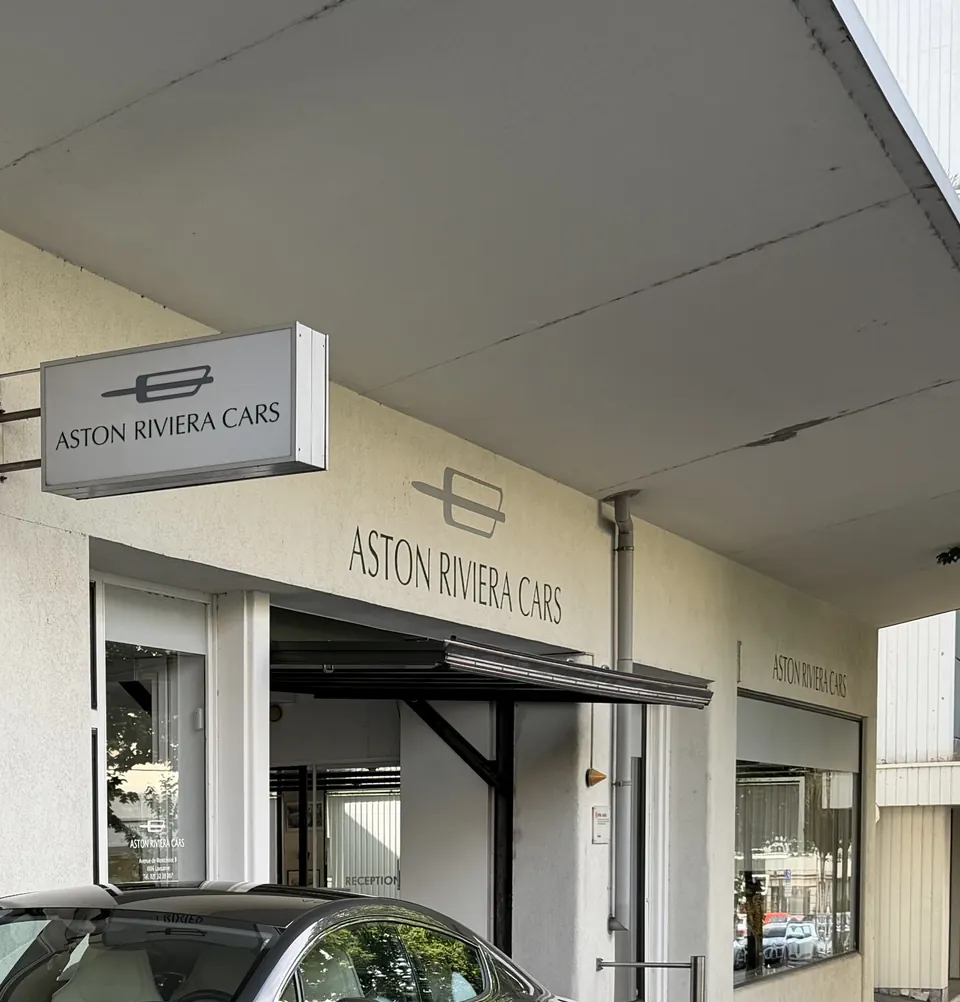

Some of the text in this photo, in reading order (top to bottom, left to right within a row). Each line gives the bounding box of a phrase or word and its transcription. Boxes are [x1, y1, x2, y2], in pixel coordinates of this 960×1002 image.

[55, 401, 280, 451] ASTON RIVIERA CARS
[349, 525, 562, 625] ASTON RIVIERA CARS
[772, 653, 848, 698] ASTON RIVIERA CARS
[129, 838, 185, 849] ASTON RIVIERA CARS
[345, 875, 400, 886] RECEPTION
